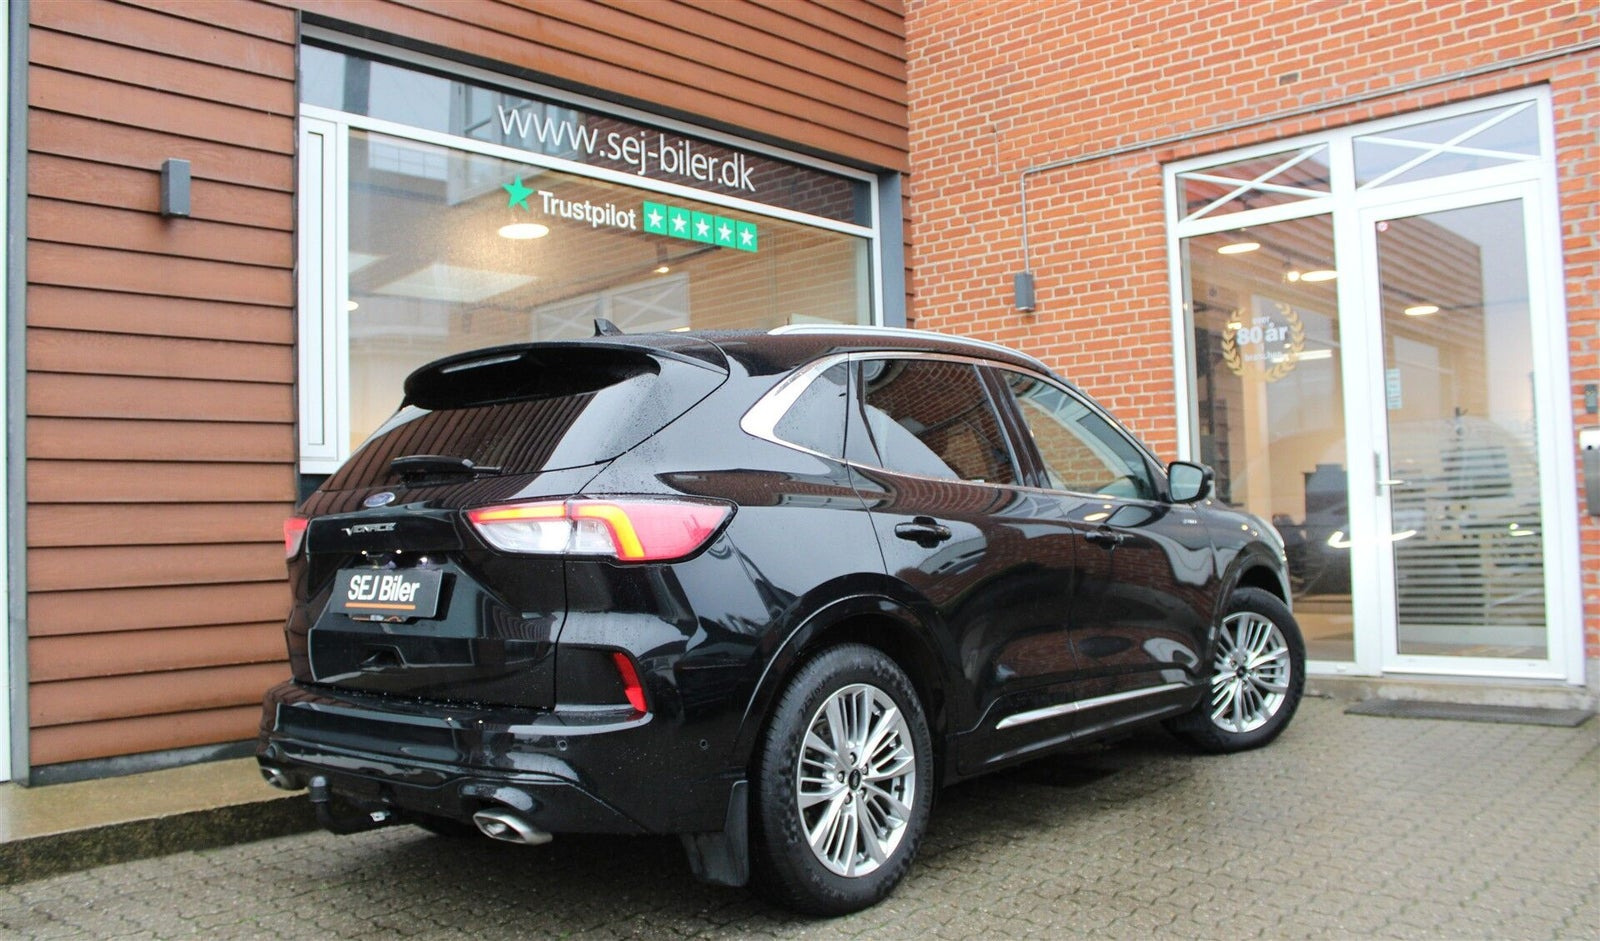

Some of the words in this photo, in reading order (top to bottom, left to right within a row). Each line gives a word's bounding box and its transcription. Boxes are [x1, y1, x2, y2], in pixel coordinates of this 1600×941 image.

[498, 105, 756, 191] www.sej-biler.dk
[538, 190, 637, 230] Trustpilot
[1236, 326, 1263, 345] 80
[1265, 321, 1289, 342] år
[347, 574, 380, 601] SEJ
[378, 575, 421, 602] Biler
